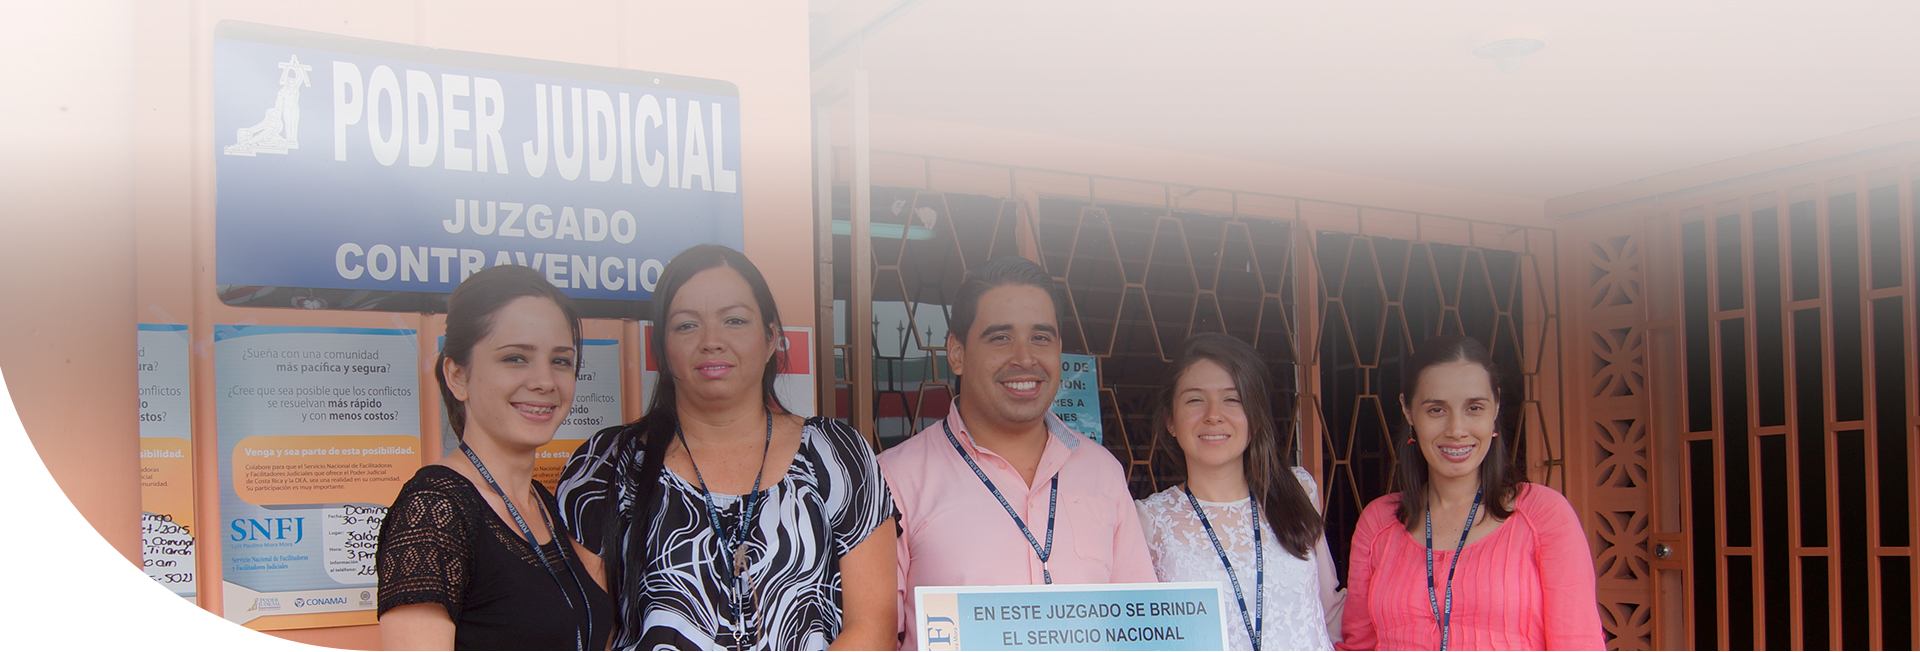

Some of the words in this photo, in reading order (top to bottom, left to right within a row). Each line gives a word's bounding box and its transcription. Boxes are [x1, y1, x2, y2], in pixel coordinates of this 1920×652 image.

[333, 60, 509, 175] PODER
[523, 83, 737, 194] JUDICIAL
[443, 199, 637, 244] JUZGADO
[243, 348, 278, 360] ¿Sueña
[281, 350, 299, 358] con
[324, 350, 379, 360] comunidad
[276, 362, 298, 372] más
[301, 362, 341, 374] pacífica
[344, 365, 350, 375] y
[352, 363, 391, 375] segura?
[1074, 362, 1089, 372] DE
[228, 385, 254, 398] ¿Cree
[257, 387, 275, 397] que
[296, 385, 330, 397] posible
[333, 387, 350, 397] que
[353, 386, 365, 396] los
[368, 386, 411, 396] conflictos
[576, 393, 614, 402] conflictos
[268, 400, 277, 408] se
[280, 398, 325, 408] resuelvan
[328, 398, 348, 408] más
[350, 398, 382, 410] rápido
[1077, 399, 1085, 407] A
[140, 412, 167, 421] stos?
[302, 413, 307, 422] y
[310, 412, 326, 420] con
[330, 412, 362, 420] menos
[364, 410, 398, 420] costos?
[569, 405, 589, 416] pido
[573, 416, 603, 425] costos?
[140, 450, 184, 458] sibilidad.
[244, 448, 274, 458] Venga
[276, 449, 282, 457] y
[302, 448, 326, 457] parte
[328, 447, 339, 455] de
[362, 446, 414, 456] posibilidad.
[142, 514, 172, 531] ingo
[231, 517, 305, 544] SNFJ
[347, 550, 355, 559] 3
[306, 597, 347, 606] CONAMAJ
[974, 606, 995, 621] EN
[1001, 605, 1041, 620] ESTE
[1046, 604, 1121, 619] JUZGADO
[1126, 603, 1145, 617] SE
[1150, 601, 1207, 616] BRINDA
[1003, 631, 1023, 645] EL
[1028, 629, 1101, 645] SERVICIO
[1106, 626, 1184, 642] NACIONAL
